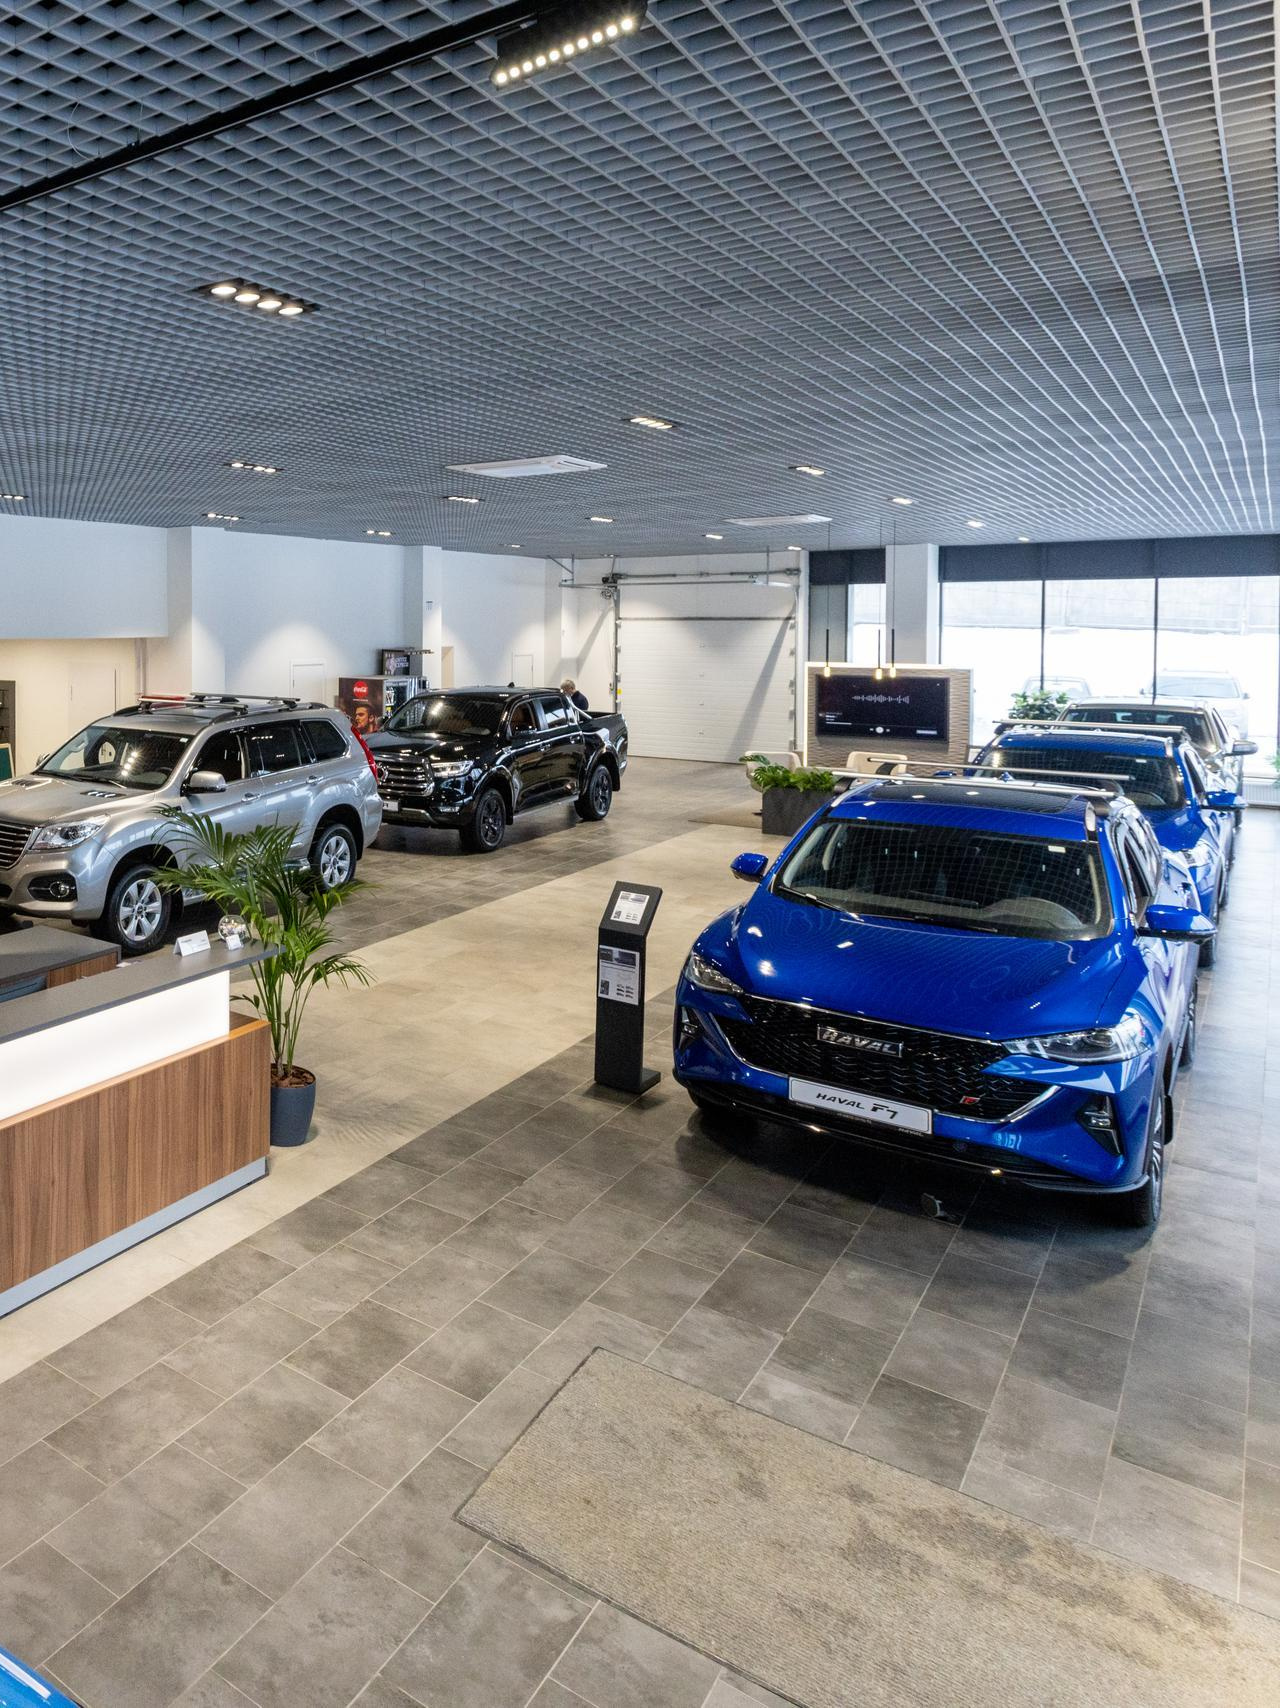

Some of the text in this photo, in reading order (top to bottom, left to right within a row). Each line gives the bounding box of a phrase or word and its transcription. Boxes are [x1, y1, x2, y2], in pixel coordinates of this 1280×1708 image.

[822, 1028, 897, 1055] HAVAL
[816, 1093, 866, 1110] HAVAL
[870, 1103, 898, 1119] F7
